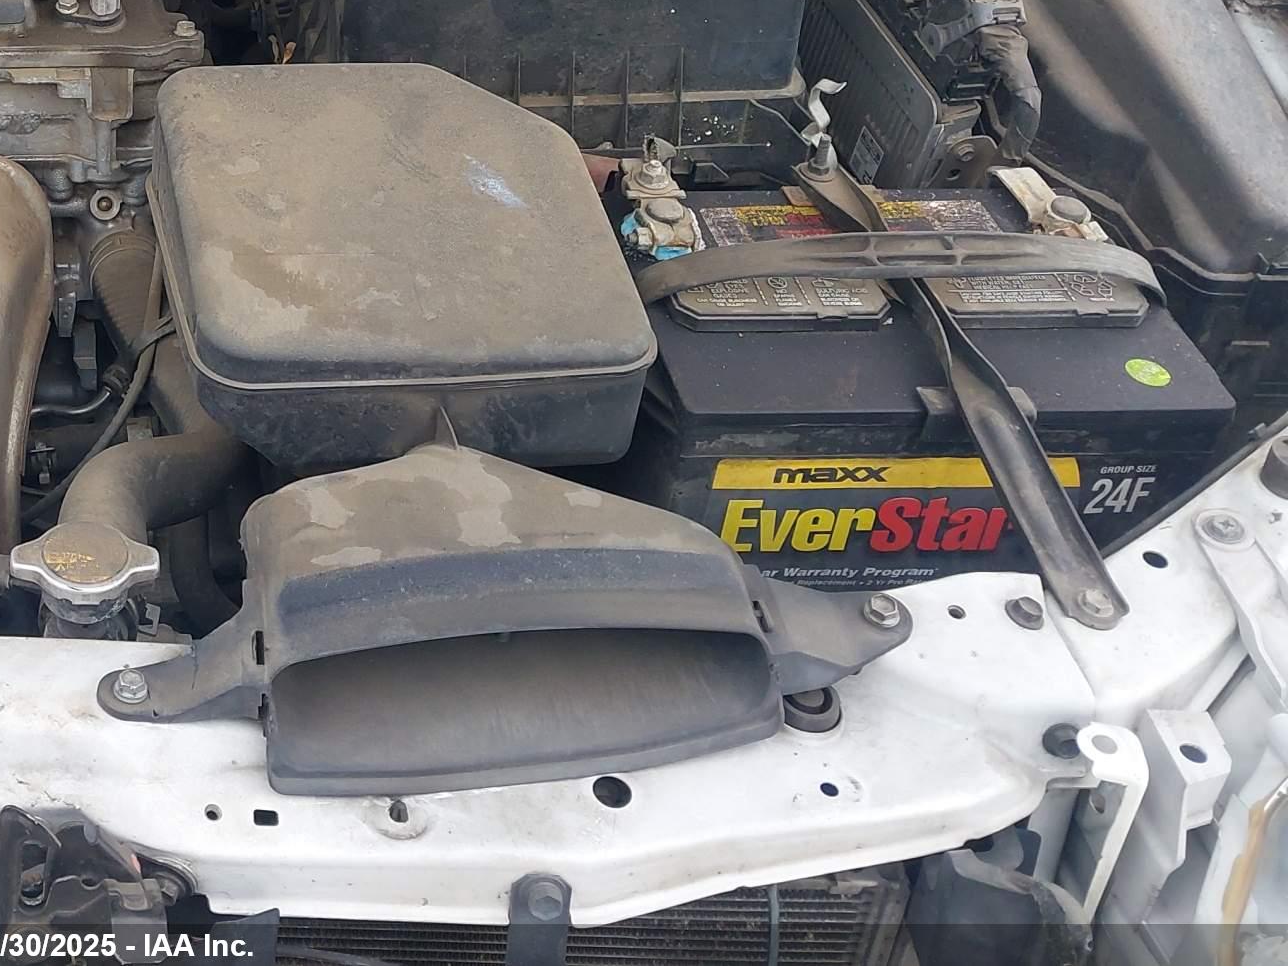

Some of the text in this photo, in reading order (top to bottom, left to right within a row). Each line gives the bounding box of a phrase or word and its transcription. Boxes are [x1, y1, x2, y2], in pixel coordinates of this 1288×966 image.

[773, 466, 890, 483] maxx
[1100, 465, 1158, 474] GROUP SIZE
[1083, 477, 1156, 514] 24F
[720, 497, 1008, 552] EverStar
[761, 567, 934, 578] ar Warranty Program
